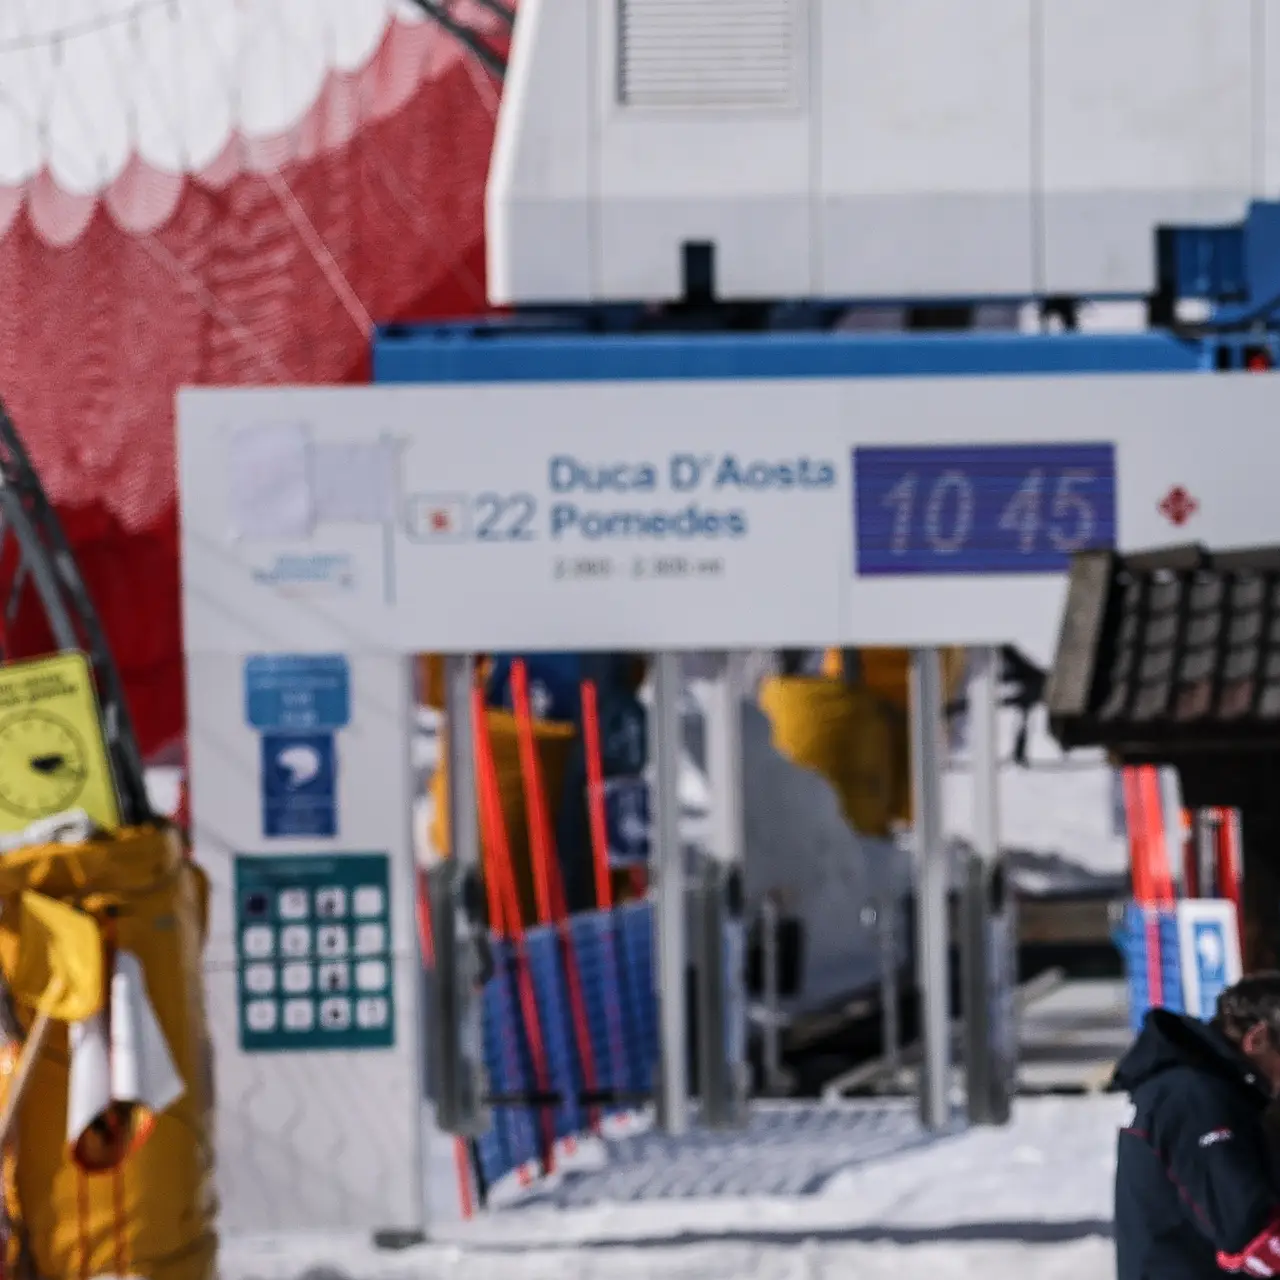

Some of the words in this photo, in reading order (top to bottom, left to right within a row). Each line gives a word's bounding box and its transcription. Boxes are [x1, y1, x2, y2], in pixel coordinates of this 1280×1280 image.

[549, 455, 656, 491] Duca
[669, 453, 835, 490] D'Aosta
[474, 496, 536, 540] 22
[550, 502, 747, 540] Pomedes
[882, 468, 974, 555] 10
[998, 467, 1097, 556] 45
